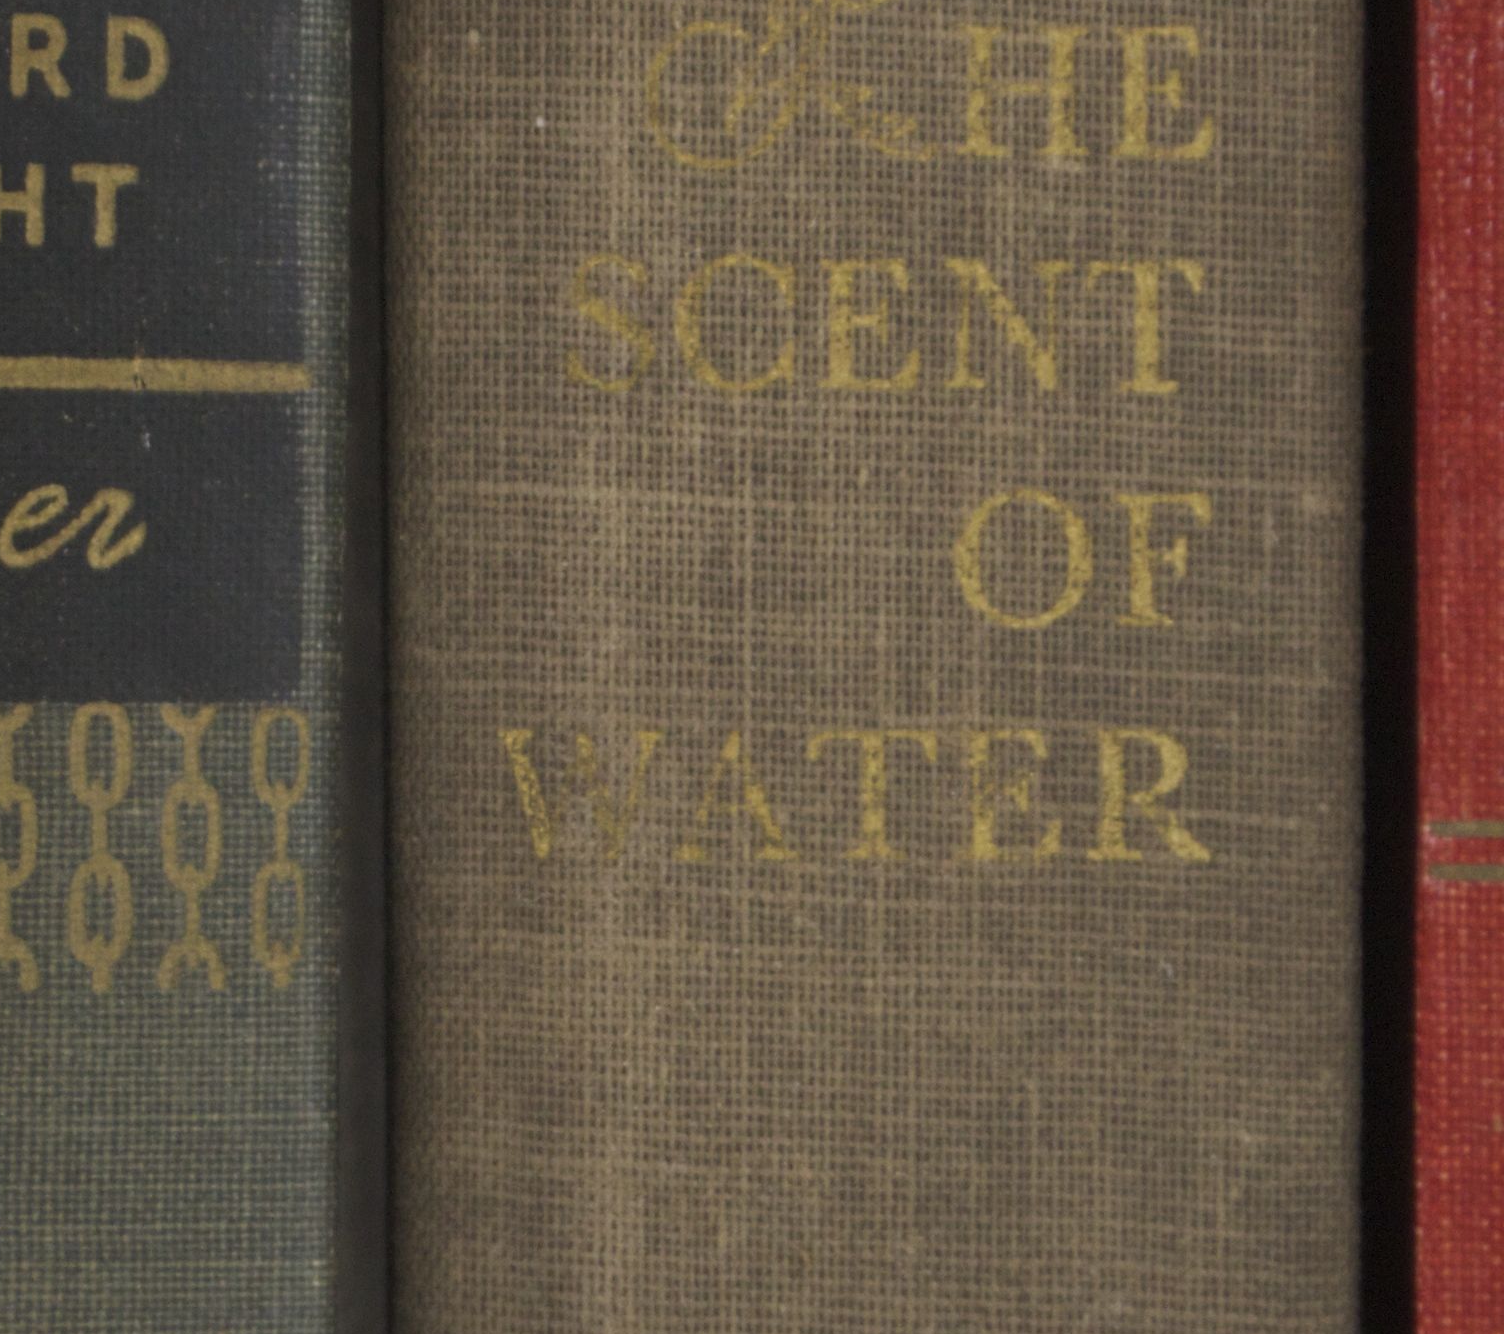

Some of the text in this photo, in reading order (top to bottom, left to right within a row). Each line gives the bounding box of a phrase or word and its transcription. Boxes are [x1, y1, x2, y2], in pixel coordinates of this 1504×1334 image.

[567, 253, 1207, 396] SCENT
[953, 488, 1213, 629] OF
[498, 726, 1212, 865] WATER
